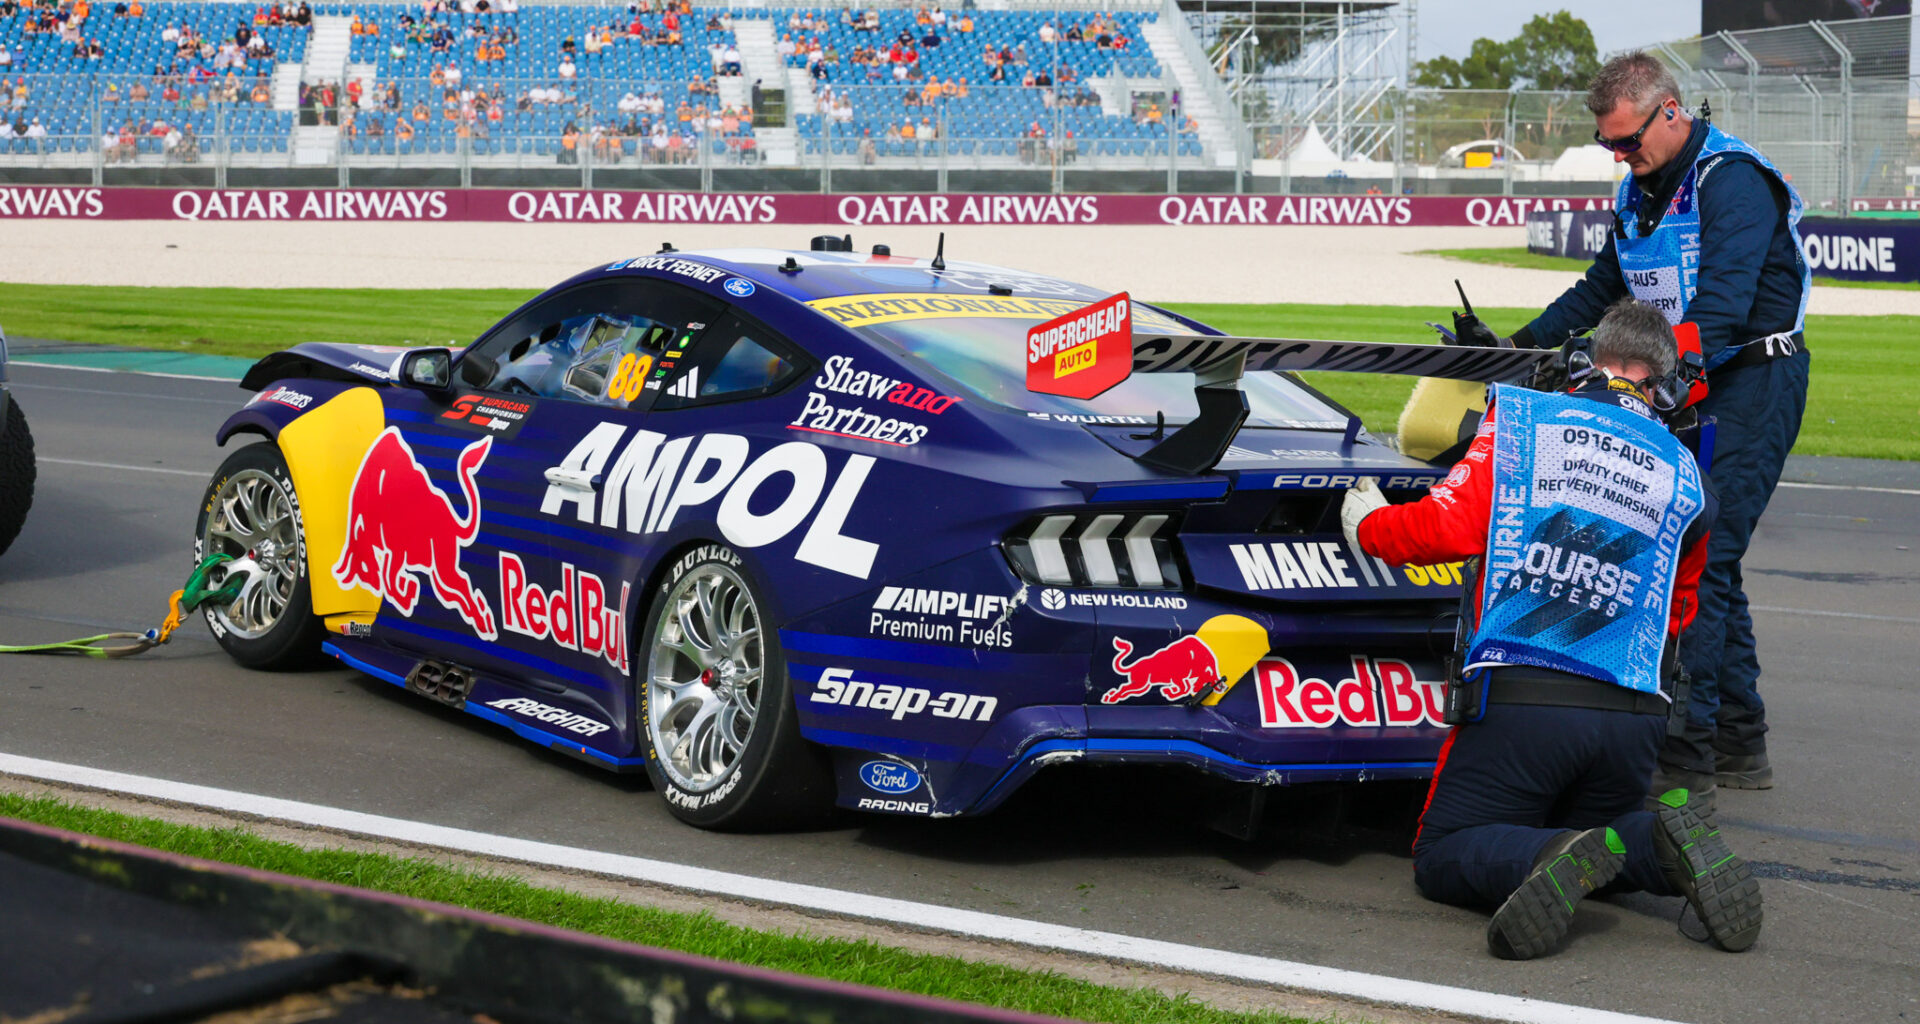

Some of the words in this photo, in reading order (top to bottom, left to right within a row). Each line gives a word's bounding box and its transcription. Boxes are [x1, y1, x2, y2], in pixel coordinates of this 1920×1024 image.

[172, 190, 291, 220] QATAR
[299, 191, 448, 219] AIRWAYS
[507, 191, 624, 222] QATAR
[632, 193, 776, 222] AIRWAYS
[837, 196, 950, 225] QATAR
[958, 196, 1098, 223] AIRWAYS
[1159, 197, 1268, 225] QATAR
[1276, 197, 1412, 224] AIRWAYS
[627, 257, 675, 271] BROC
[666, 259, 726, 283] FEENEY
[1803, 233, 1896, 272] OURNE
[1628, 271, 1658, 287] -AUS
[822, 297, 1042, 322] NATIONAL
[1029, 299, 1128, 364] SUPERCHEAP
[608, 353, 653, 402] 88
[1059, 348, 1093, 371] AUTO
[476, 406, 524, 421] CHAMPIONSHIP
[482, 397, 530, 414] SUPERCARS
[790, 391, 929, 446] Partners
[1563, 428, 1655, 471] 0916-AUS
[540, 421, 880, 580] AMPOL
[1538, 478, 1602, 496] RECVERY
[1603, 488, 1661, 524] MARSHAL
[1612, 472, 1650, 495] CHIEF
[1643, 446, 1699, 616] MELBOURNE
[673, 544, 743, 584] DUNLOP
[1229, 542, 1359, 591] MAKE
[499, 551, 579, 651] Red
[894, 587, 1009, 620] AMPLIFY
[1070, 593, 1109, 607] NEW
[1111, 594, 1188, 610] HOLLAND
[1509, 573, 1619, 618] ACCESS
[869, 612, 953, 643] Premium
[960, 620, 1013, 648] Fuels
[1481, 649, 1506, 660] FIA
[810, 667, 998, 721] Snap-on
[1253, 655, 1381, 728] Red
[496, 697, 611, 737] FREIGHTER
[858, 798, 930, 814] RACING
